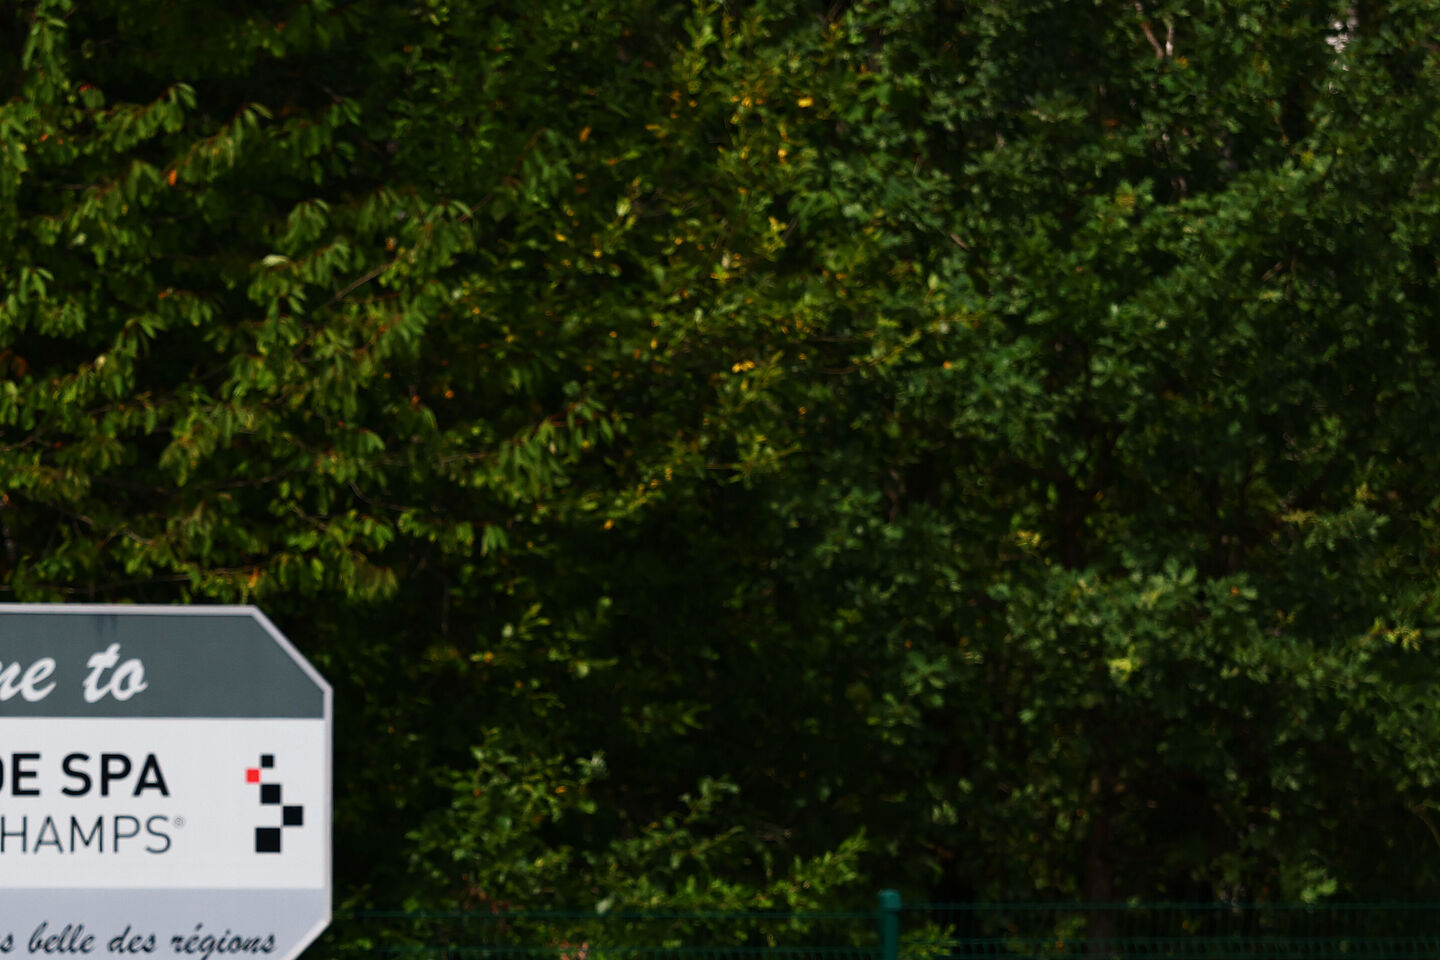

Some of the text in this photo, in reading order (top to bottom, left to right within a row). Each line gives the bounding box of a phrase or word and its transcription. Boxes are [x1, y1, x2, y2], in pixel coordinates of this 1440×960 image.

[82, 643, 148, 703] to
[61, 752, 171, 798] SPA
[27, 921, 97, 955] belle
[107, 925, 158, 955] des
